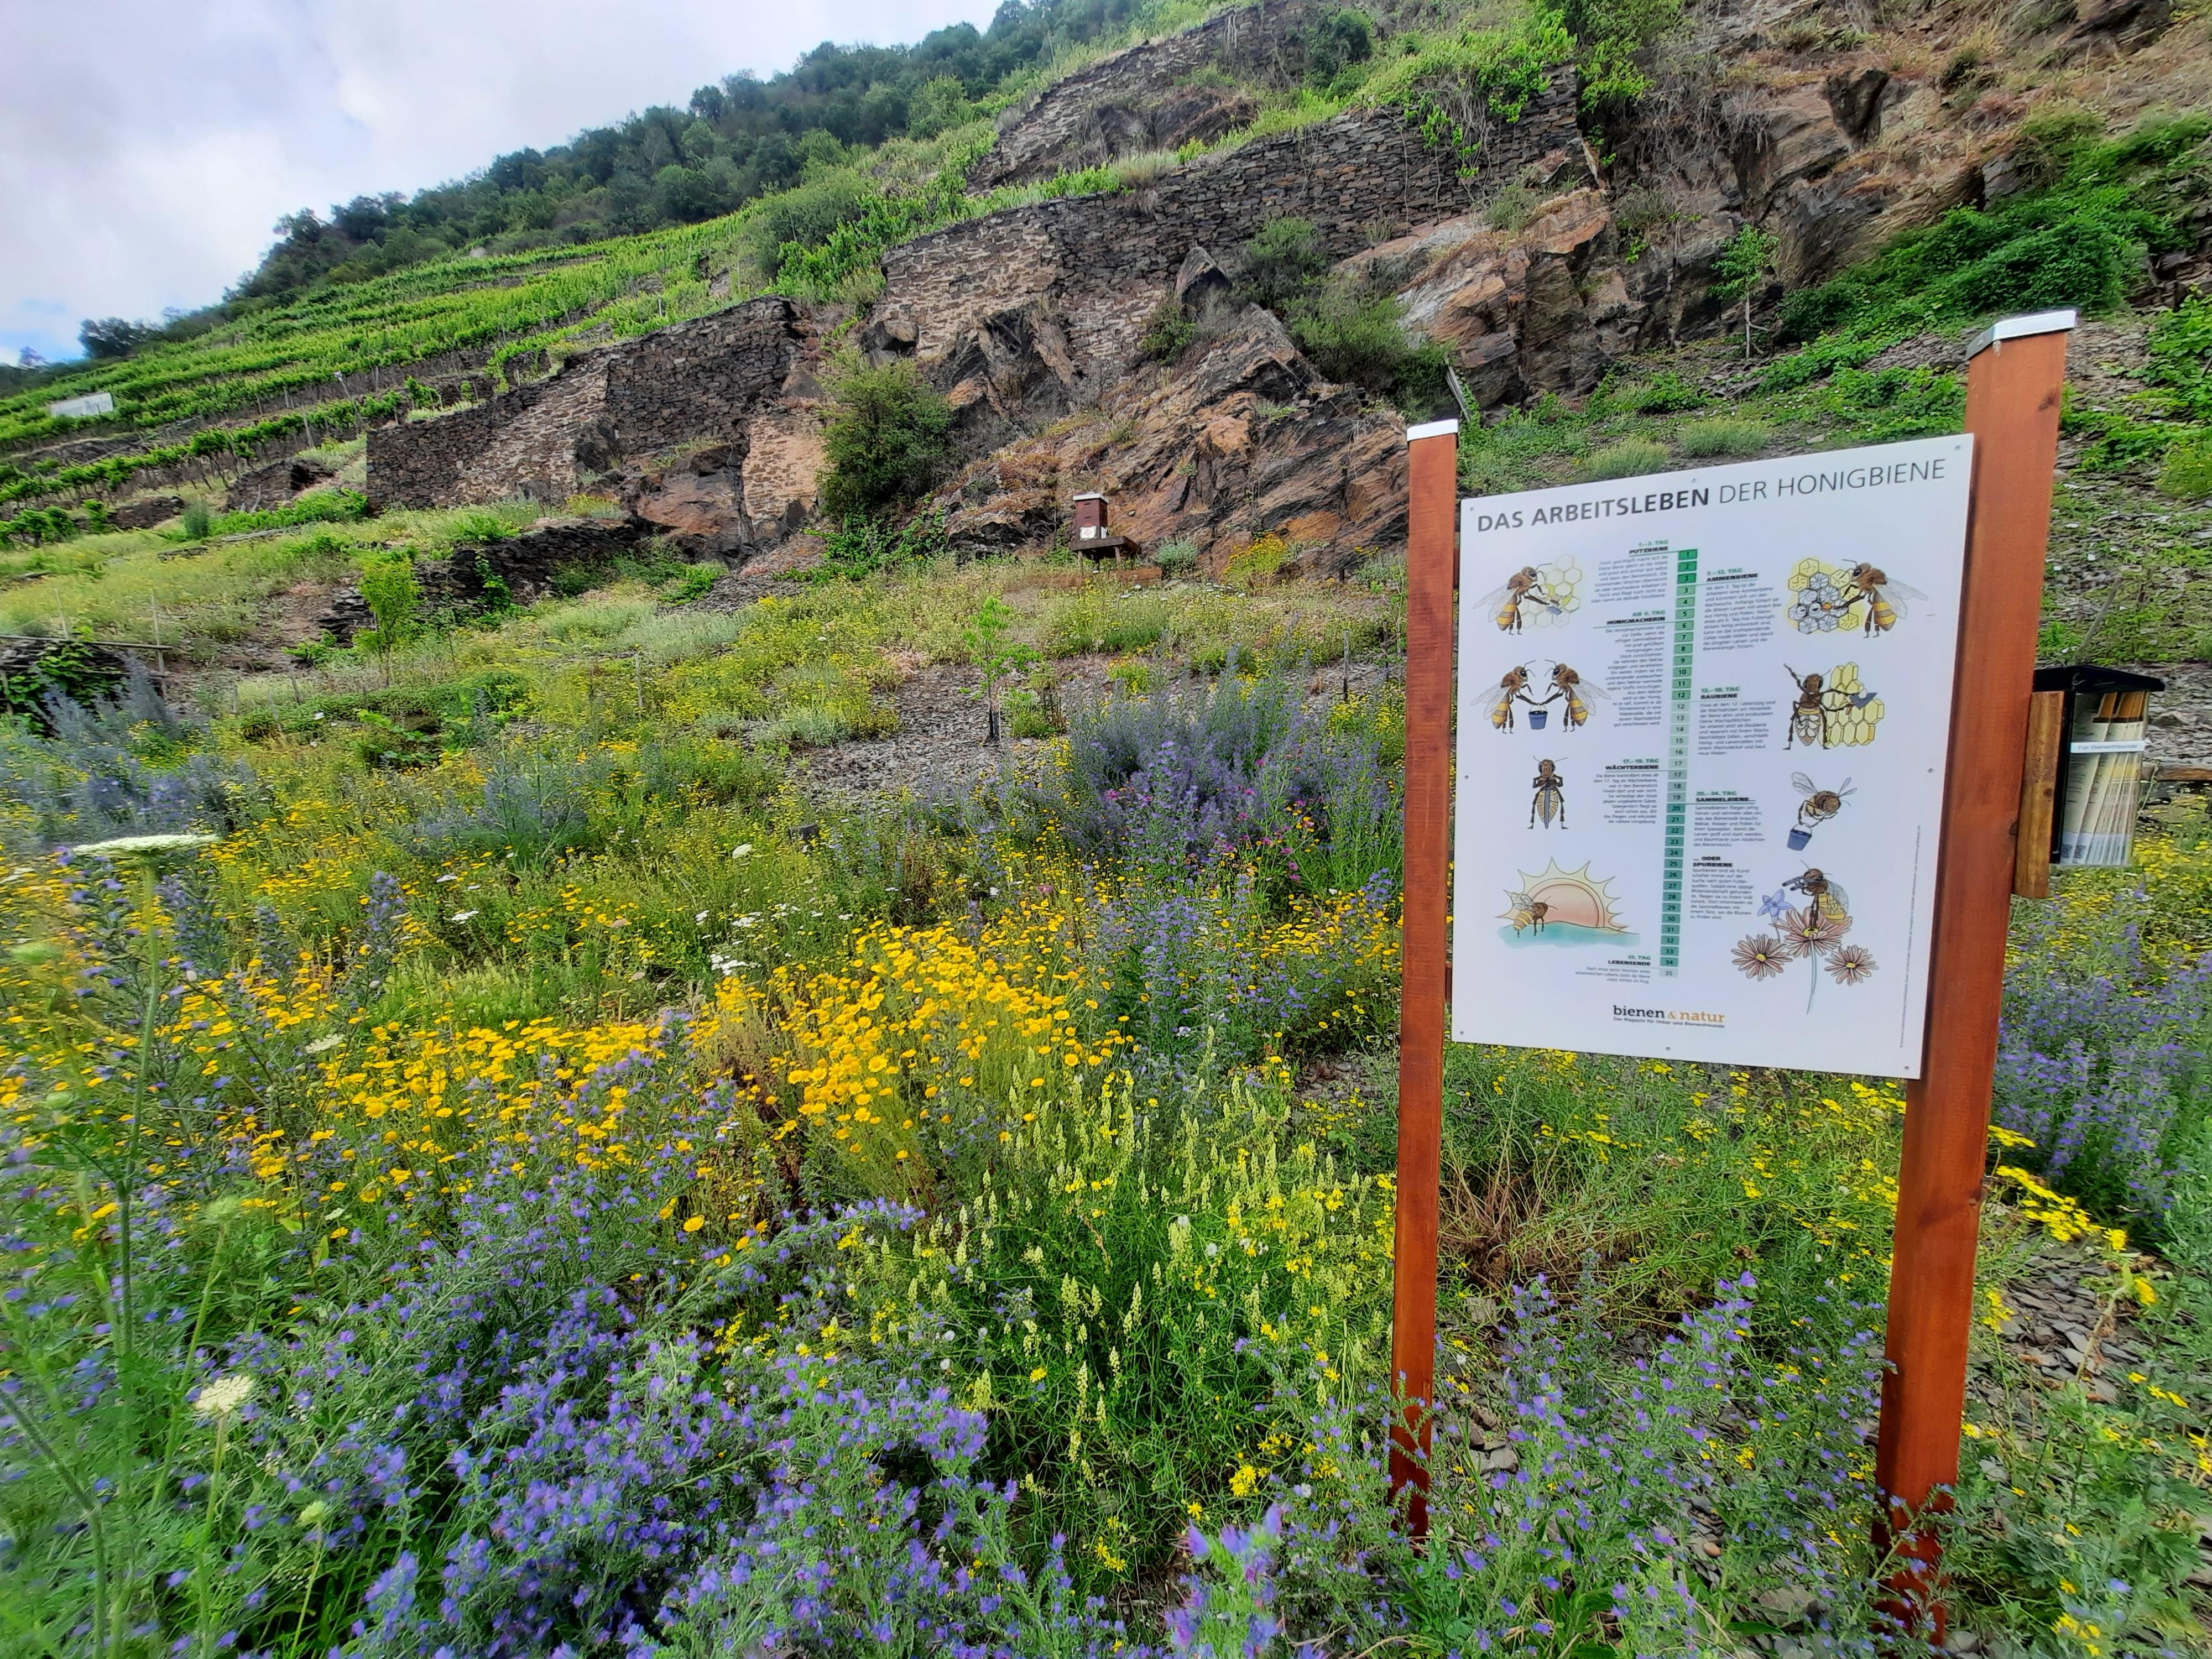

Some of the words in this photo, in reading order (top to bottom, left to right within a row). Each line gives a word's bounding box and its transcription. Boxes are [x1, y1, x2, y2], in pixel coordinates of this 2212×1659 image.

[1477, 510, 1524, 532] DAS
[1531, 488, 1709, 525] ARBEITSLEBEN
[1719, 480, 1767, 504] DER
[1778, 458, 1946, 497] HONIGBIENE
[1629, 546, 1668, 554] PUTZBIENE
[1707, 573, 1758, 582] AMMENBIENE
[1606, 616, 1665, 625] HONIGMACHERIN
[1613, 1005, 1665, 1019] bienen
[1667, 1011, 1676, 1019] &
[1679, 1010, 1725, 1022] natur
